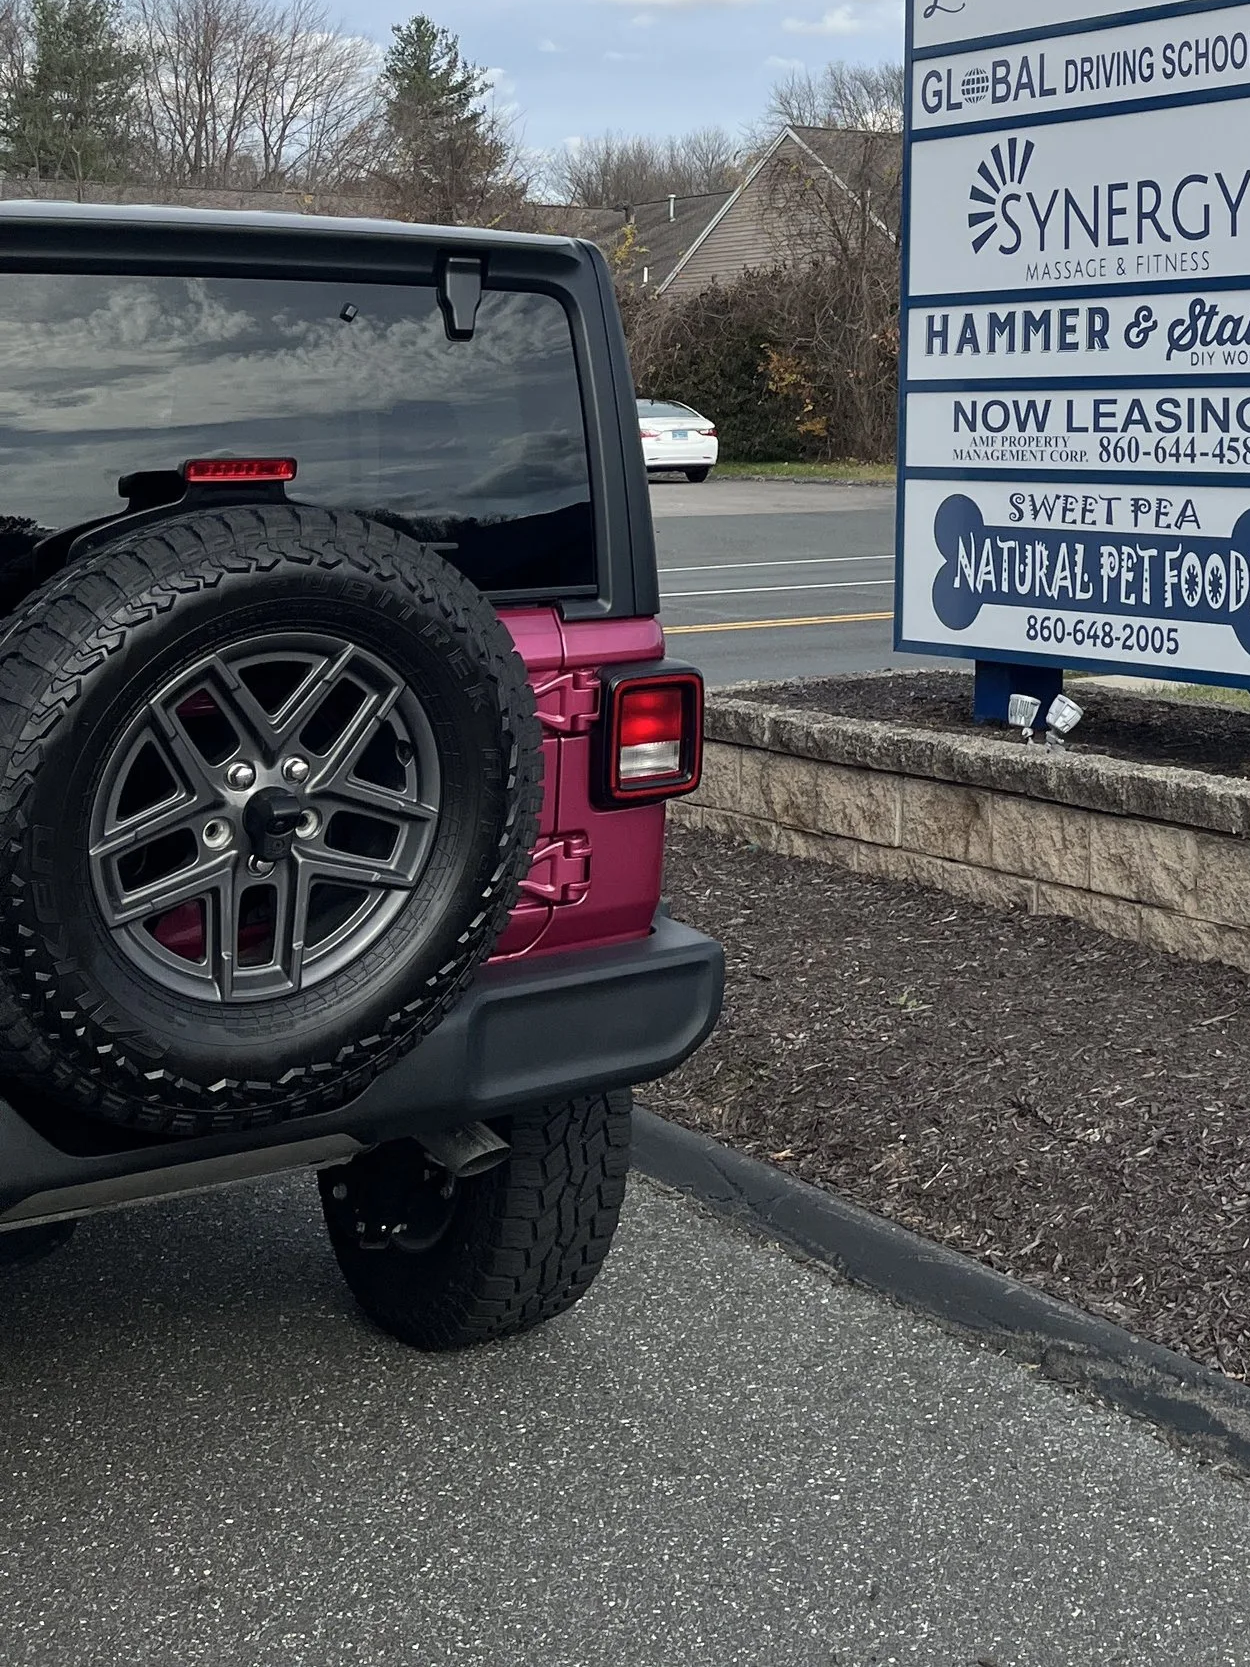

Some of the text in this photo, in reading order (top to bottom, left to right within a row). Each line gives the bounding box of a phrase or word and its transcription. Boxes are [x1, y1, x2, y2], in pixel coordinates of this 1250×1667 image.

[1065, 46, 1155, 94] DRIVING
[1025, 250, 1211, 282] MASSAGE & FITNESS
[924, 307, 1110, 357] HAMMER
[1123, 304, 1159, 350] &
[1190, 350, 1215, 367] DIY
[952, 399, 1052, 433] NOW
[952, 449, 1089, 464] MANAGEMENT CORP.
[969, 435, 1071, 449] AMF PROPERTY
[1008, 492, 1202, 531] SWEET PEA
[953, 532, 1094, 601] NATURAL
[1100, 543, 1158, 607] PET
[1025, 614, 1180, 656] 860-648-2005
